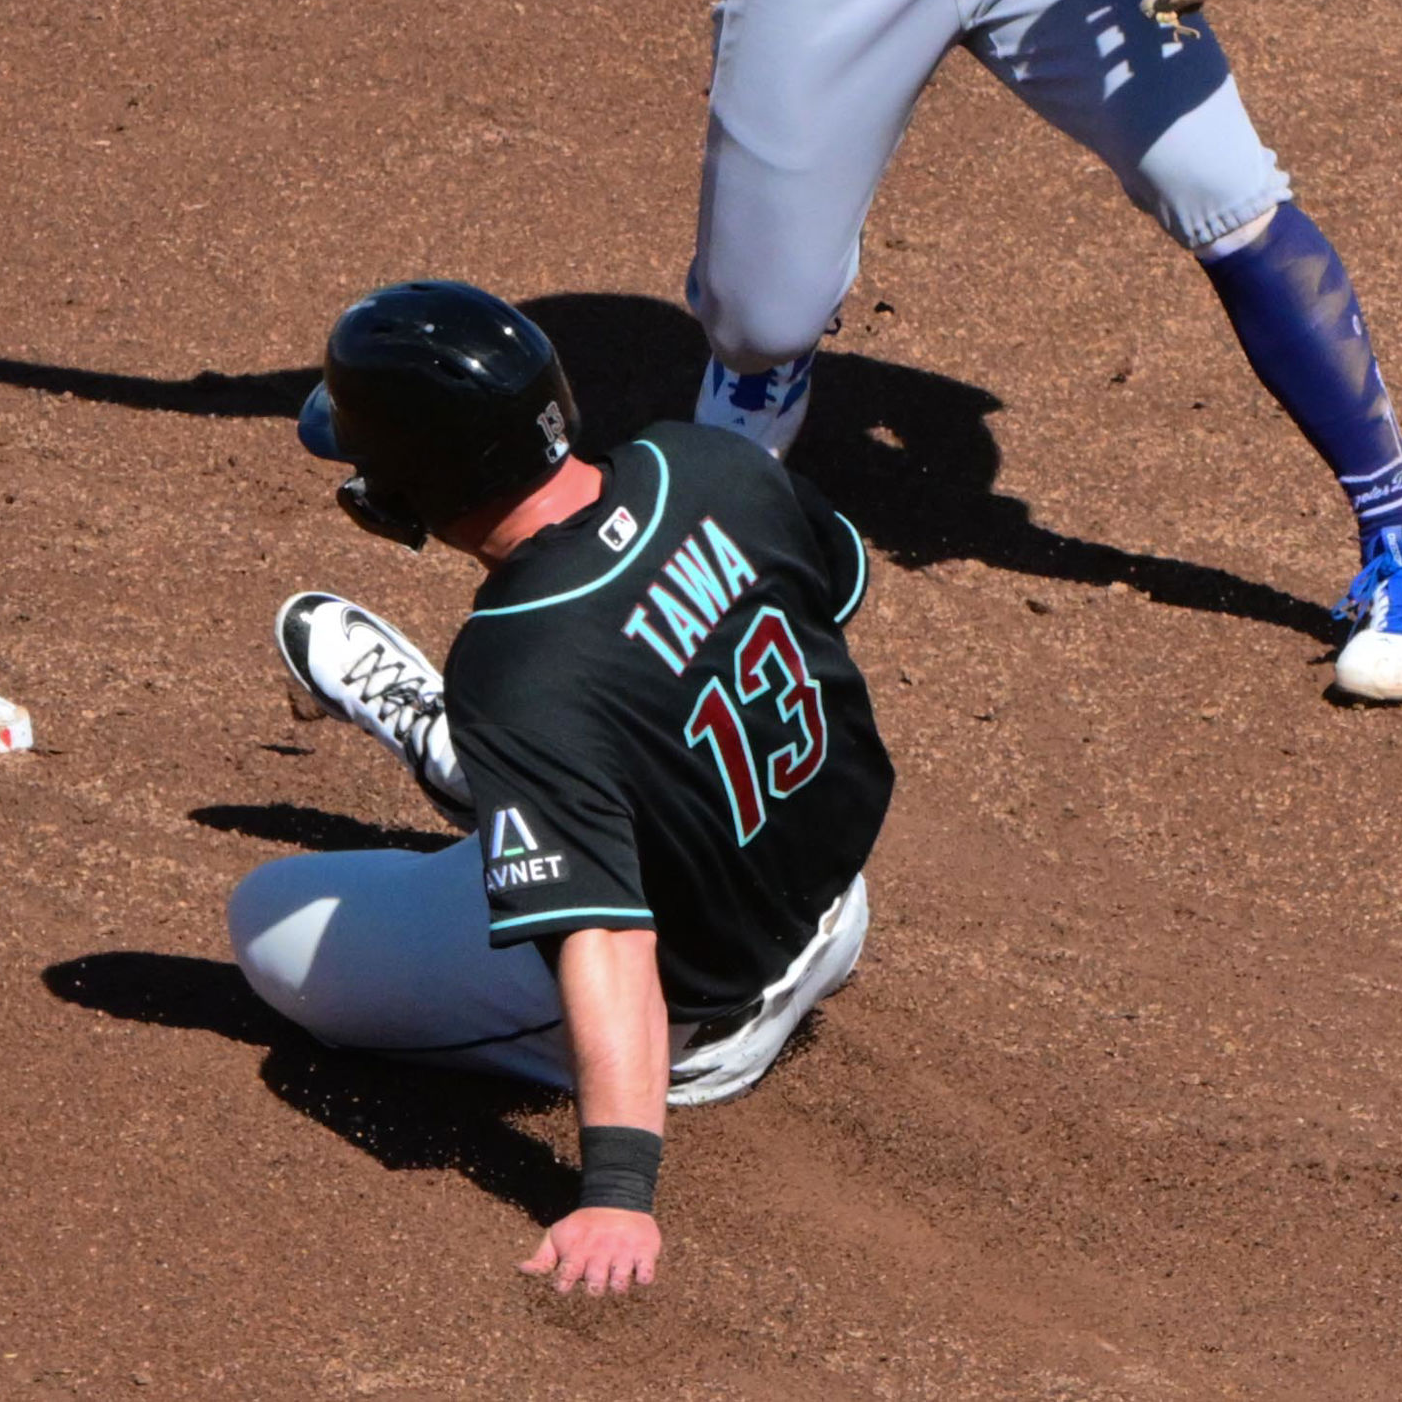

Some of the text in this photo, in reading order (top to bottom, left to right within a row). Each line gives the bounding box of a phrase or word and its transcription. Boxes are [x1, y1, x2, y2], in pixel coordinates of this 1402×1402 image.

[536, 400, 566, 443] 13
[624, 518, 758, 676] TAWA
[683, 605, 827, 848] 13
